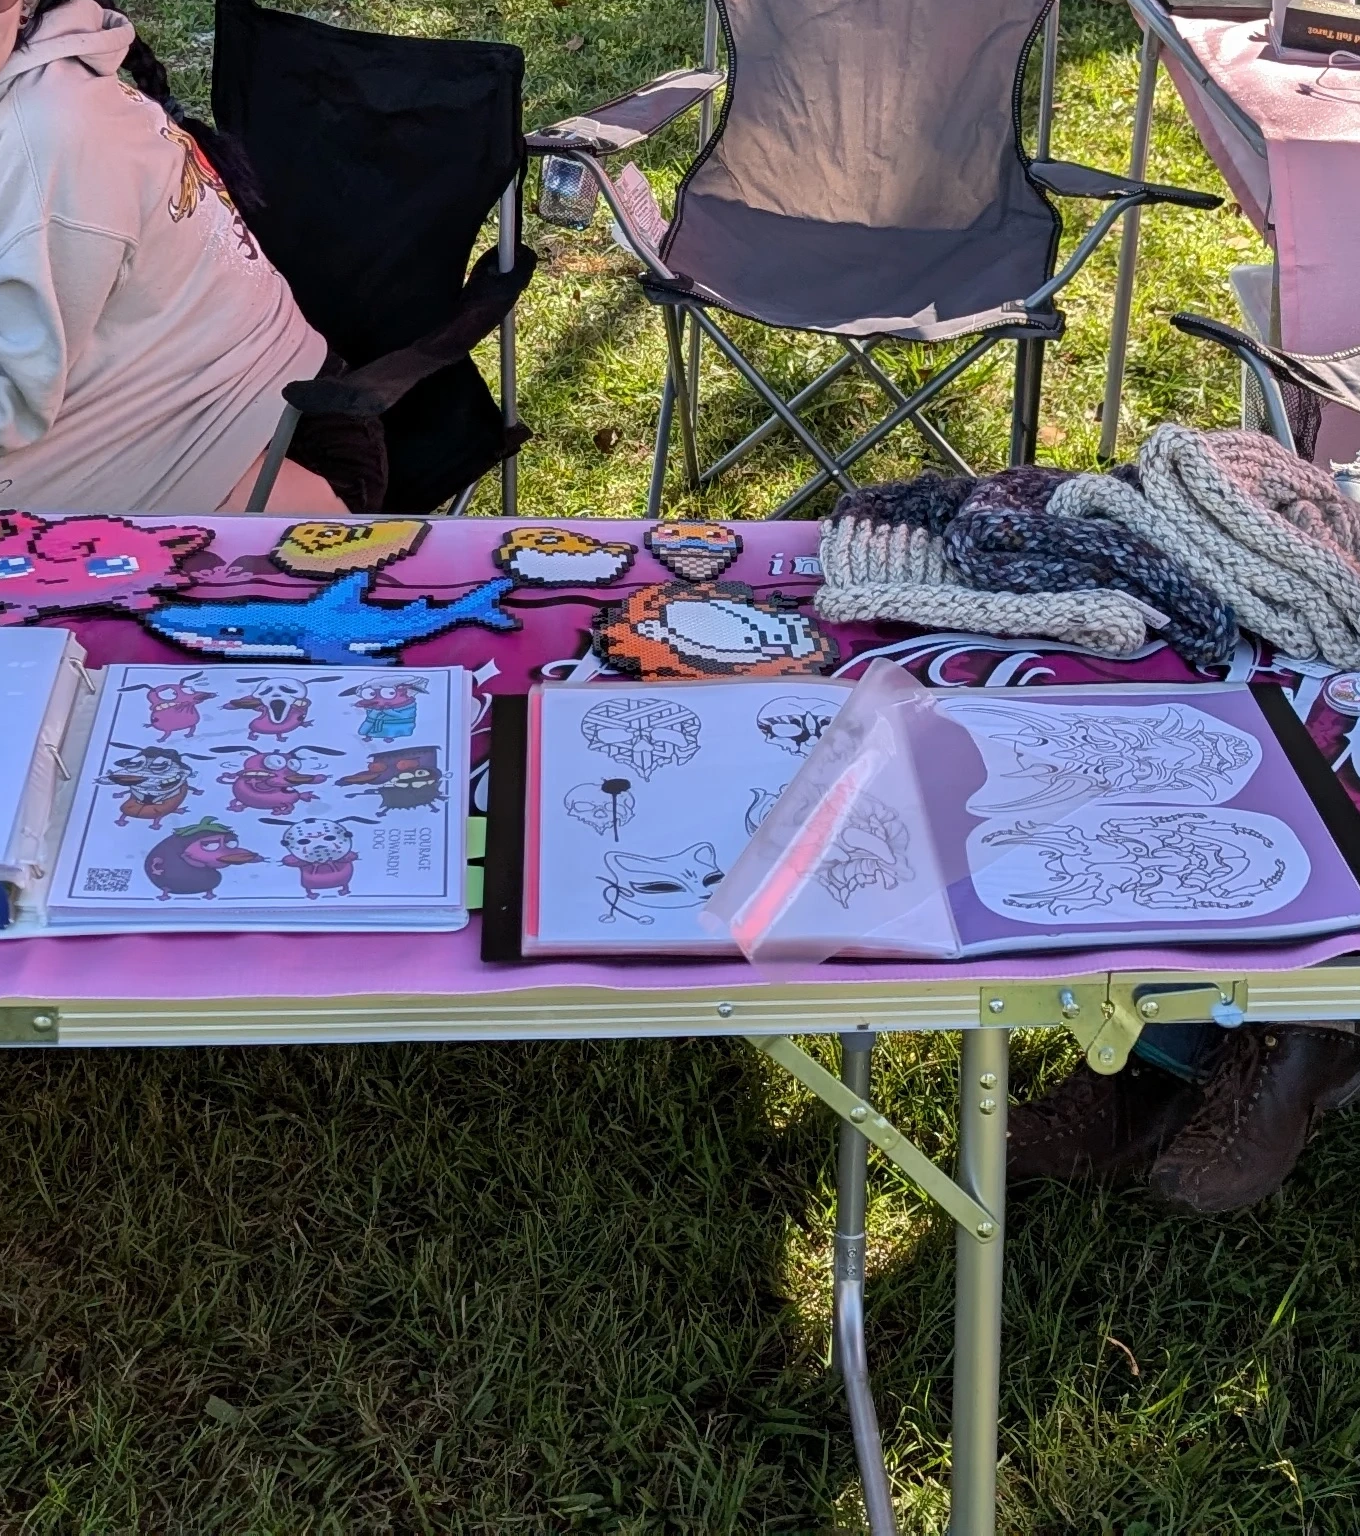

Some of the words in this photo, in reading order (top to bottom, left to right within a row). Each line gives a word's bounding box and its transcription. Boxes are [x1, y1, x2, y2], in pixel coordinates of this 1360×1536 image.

[1307, 26, 1335, 39] Tarot
[372, 829, 386, 850] DOG
[403, 828, 417, 845] THE
[386, 828, 401, 879] COWARDLY
[418, 827, 432, 871] COURAGE
